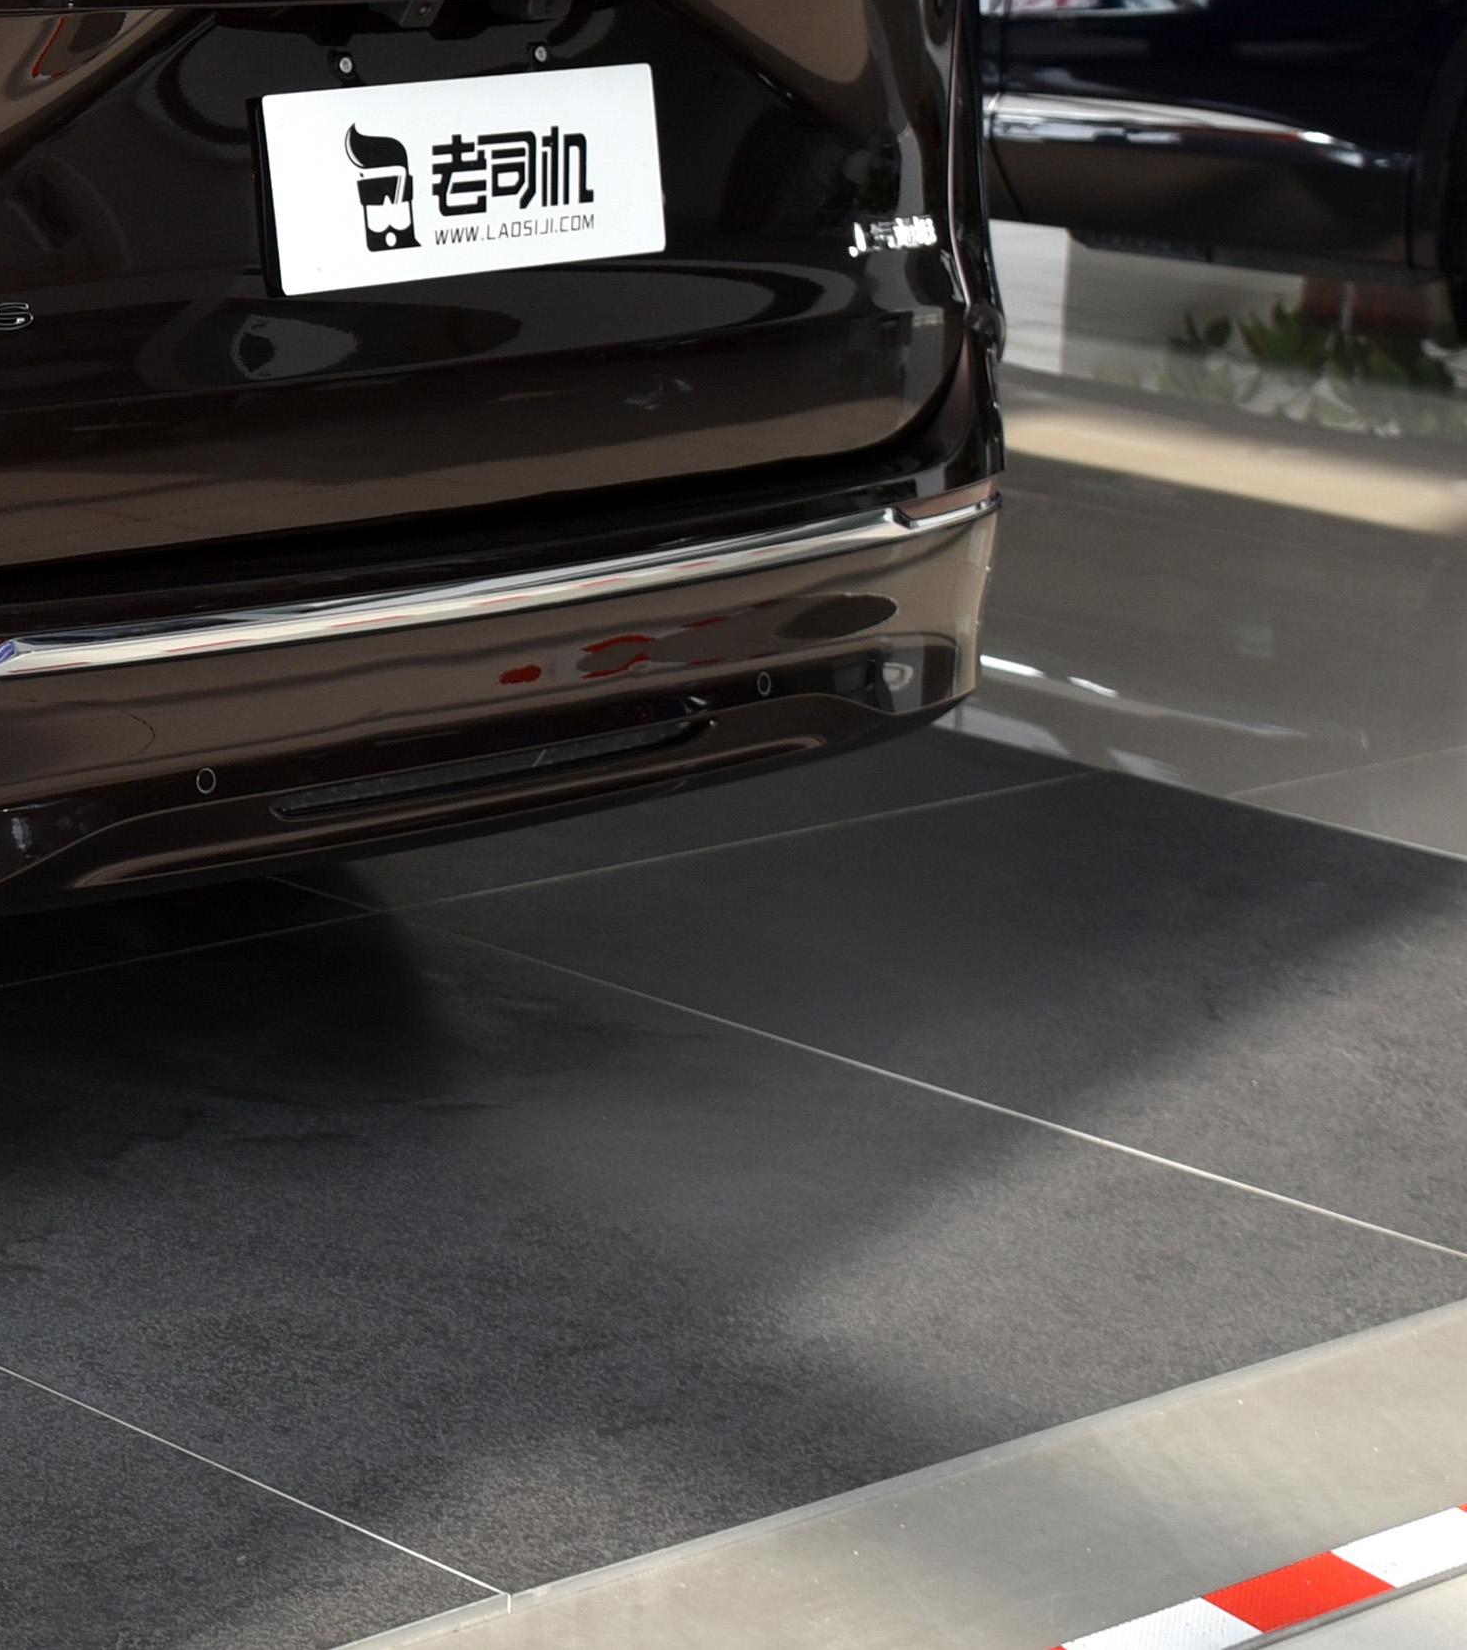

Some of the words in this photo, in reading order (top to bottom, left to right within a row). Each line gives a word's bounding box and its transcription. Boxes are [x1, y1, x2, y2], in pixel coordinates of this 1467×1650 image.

[432, 125, 595, 216] 老司机
[434, 213, 595, 246] WWW.LAOSIJI.COM
